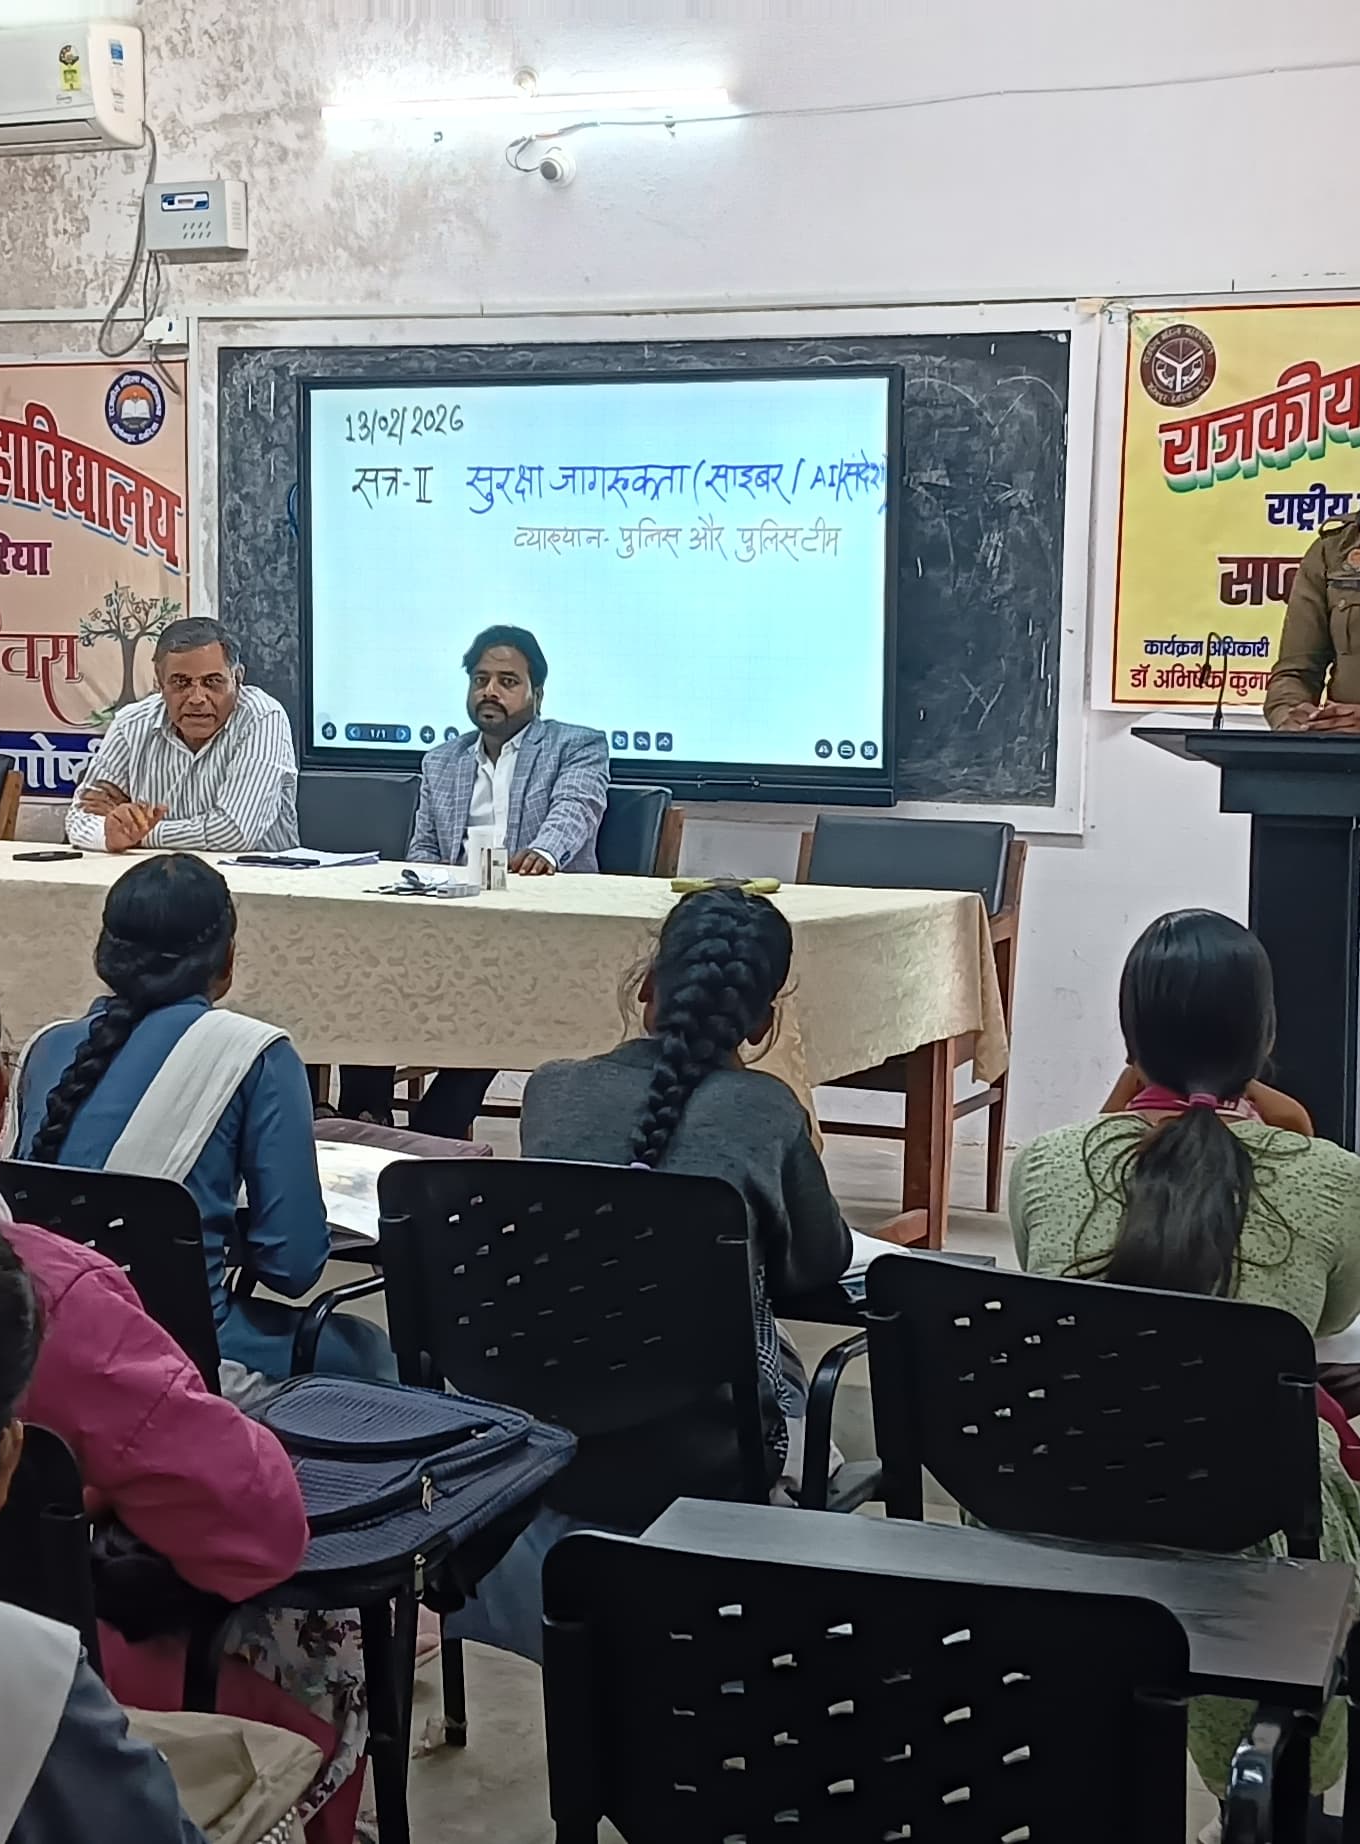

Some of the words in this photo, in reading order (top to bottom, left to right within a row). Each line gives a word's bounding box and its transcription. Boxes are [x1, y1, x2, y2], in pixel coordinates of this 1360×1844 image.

[345, 403, 465, 446] 13/02/2026
[466, 464, 544, 514] सुरक्षा
[1265, 484, 1353, 531] राष्ट्रीय
[616, 517, 683, 560] पुलिस
[688, 512, 728, 562] और
[1144, 634, 1203, 658] कार्यक्रम
[1210, 635, 1270, 658] अधिकारी
[1130, 664, 1151, 689] डॉ
[1229, 671, 1271, 696] कुमा
